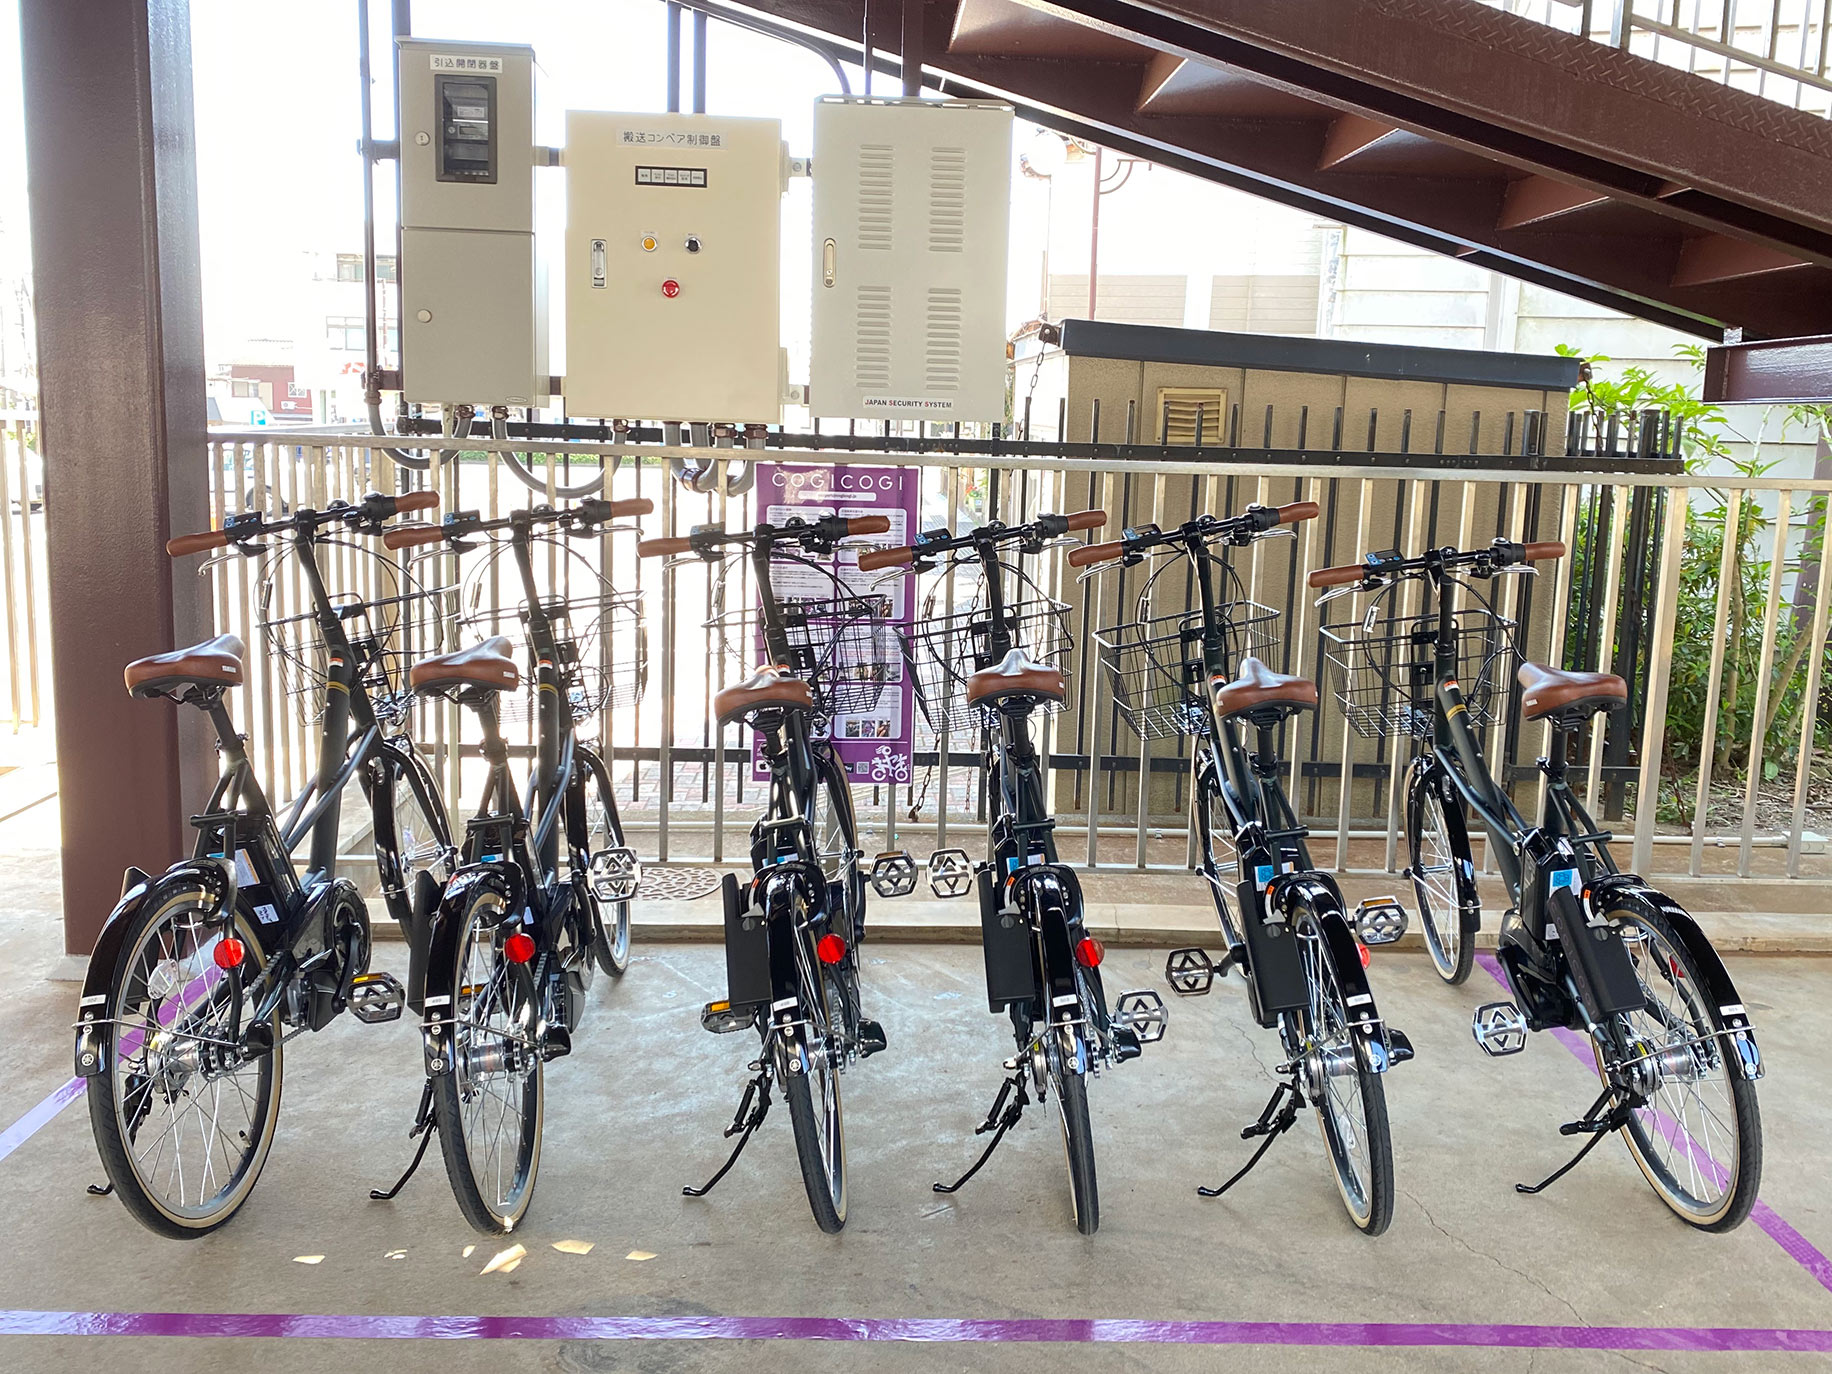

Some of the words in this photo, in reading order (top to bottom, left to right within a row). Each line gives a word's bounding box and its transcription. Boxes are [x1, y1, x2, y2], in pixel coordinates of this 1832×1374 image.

[434, 57, 500, 70] 引込開閉器盤
[623, 131, 721, 147] 搬送コンベア制御盤
[772, 472, 903, 491] COGICOGI
